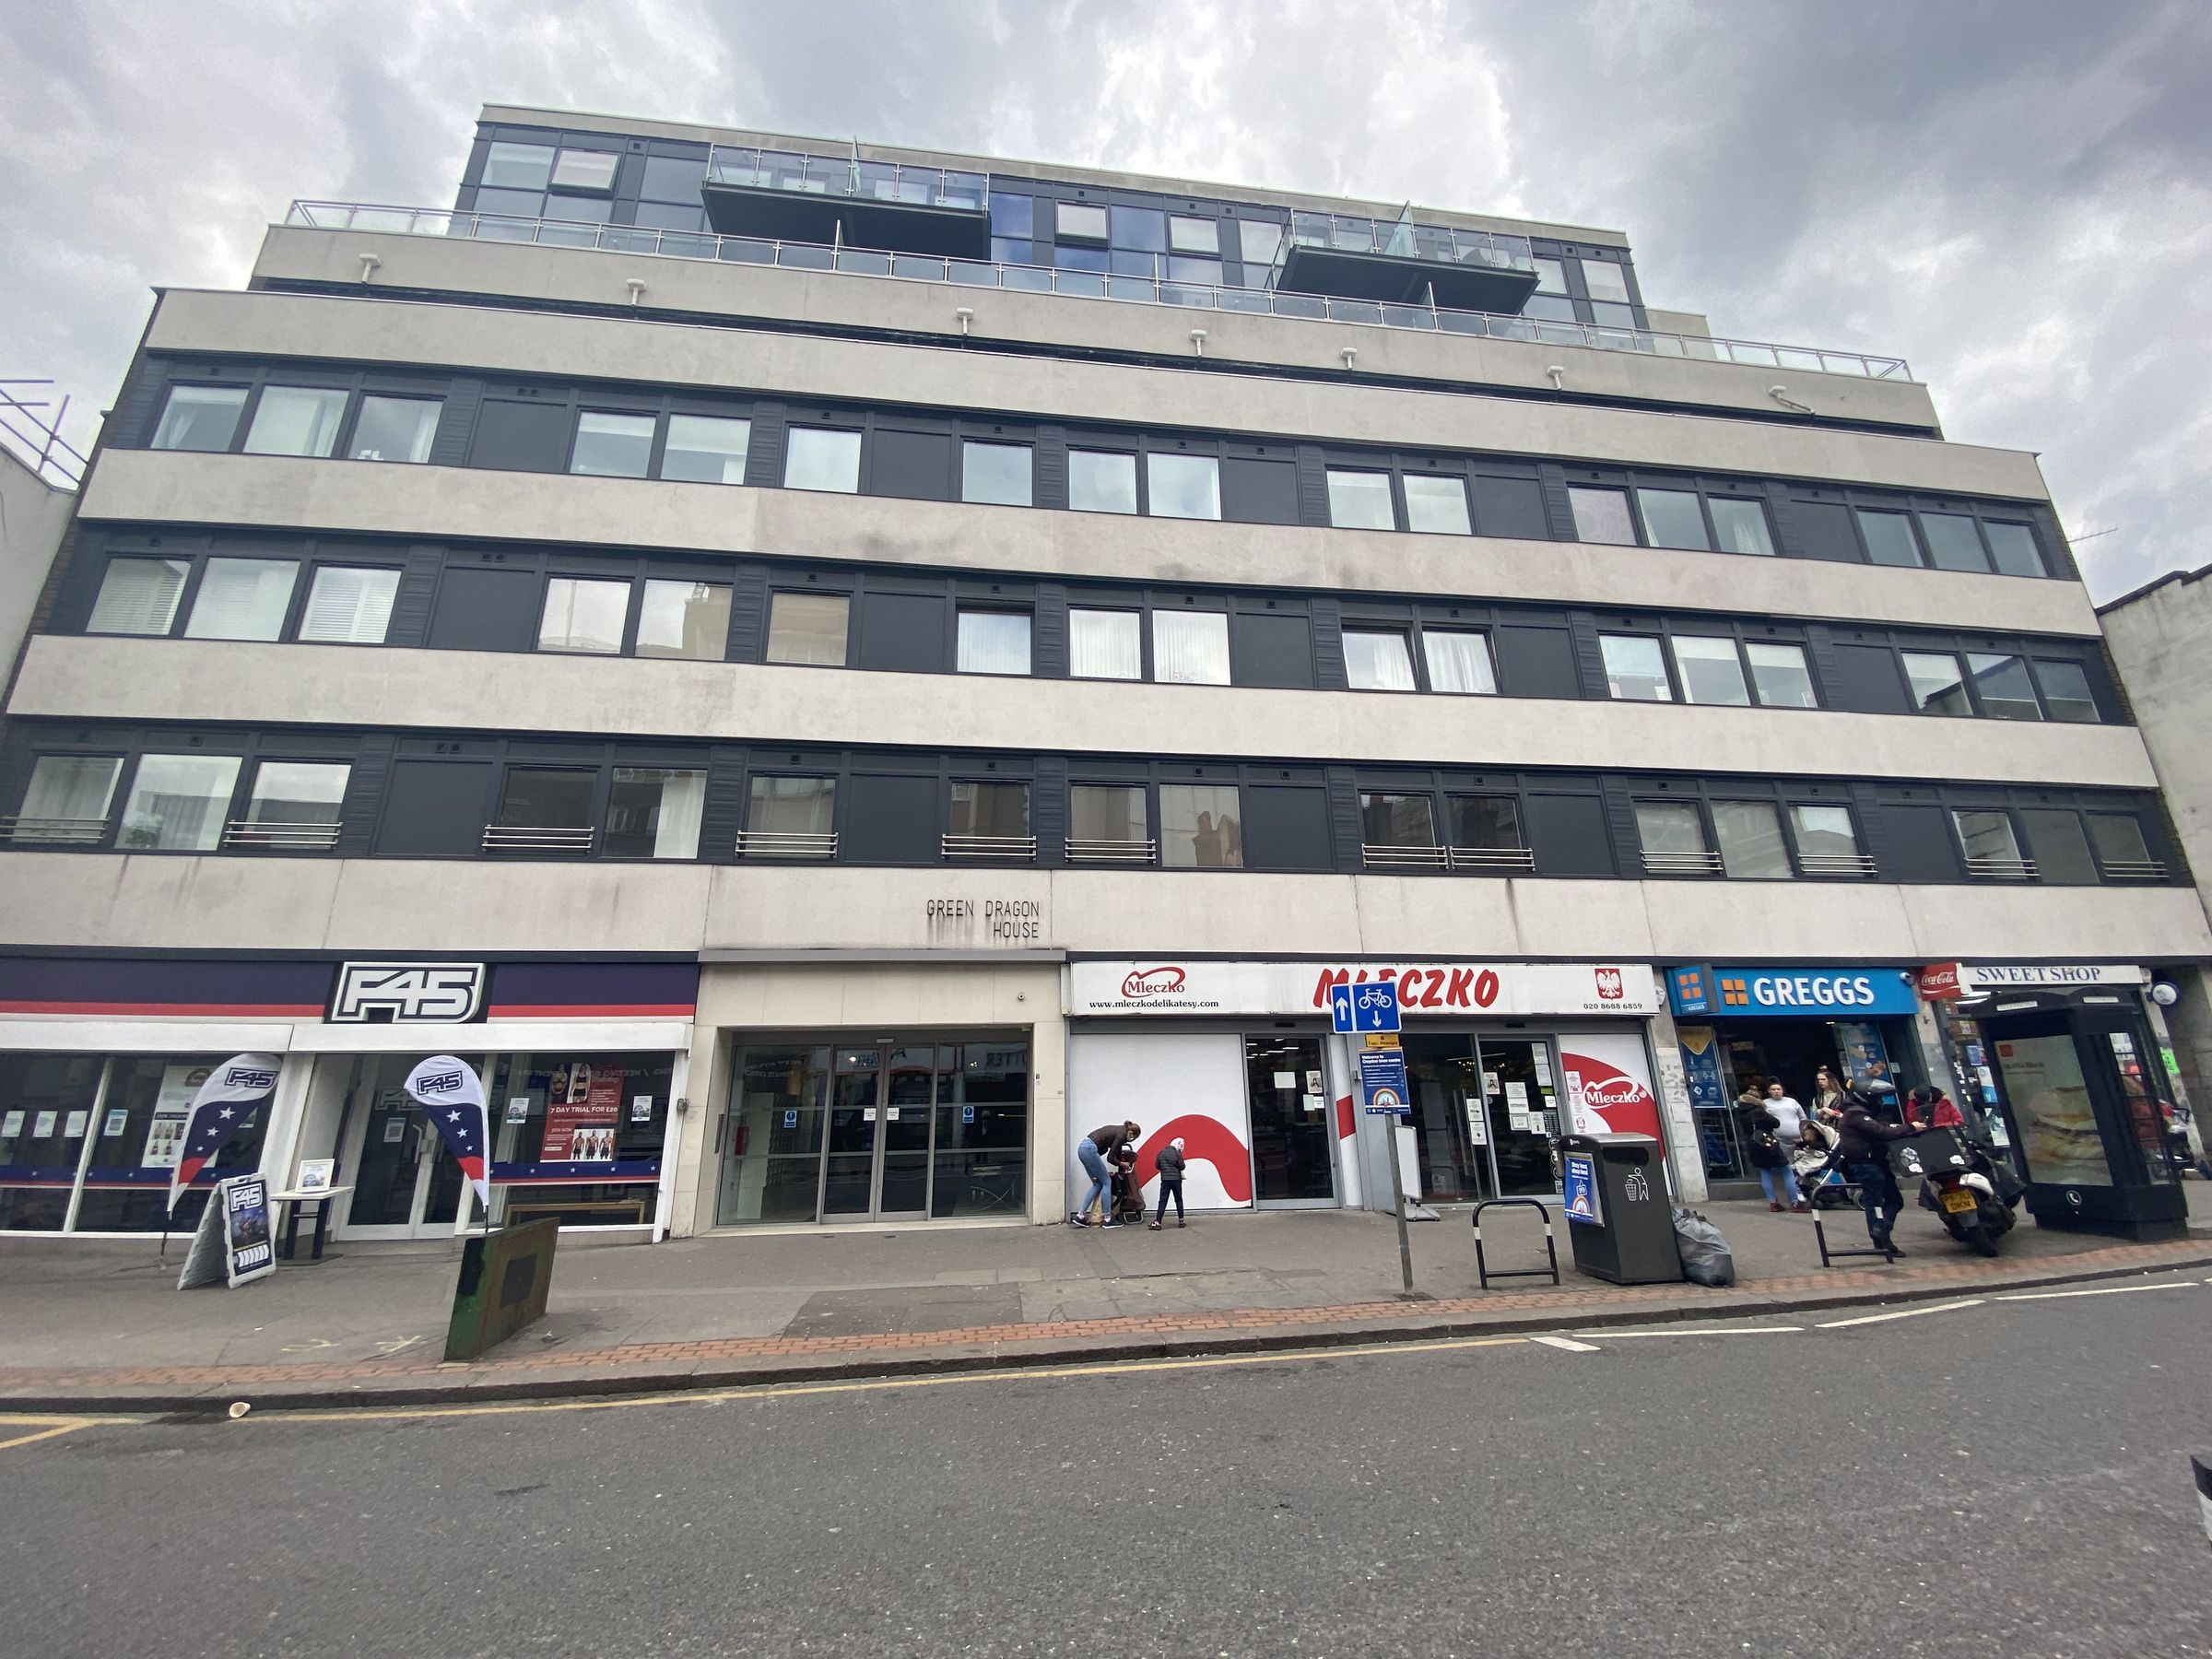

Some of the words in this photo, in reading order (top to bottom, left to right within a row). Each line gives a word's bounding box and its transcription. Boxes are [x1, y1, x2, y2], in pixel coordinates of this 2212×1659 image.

[927, 899, 974, 917] GREEN
[985, 900, 1040, 918] DRAGON
[994, 922, 1040, 938] HOUSE
[1977, 967, 2046, 982] SWEET
[2050, 967, 2100, 982] SHOP
[335, 964, 483, 1020] F45
[1127, 978, 1185, 994] Mleczko
[1753, 977, 1875, 1006] GREGGS
[1088, 998, 1219, 1009] www.mleczkodelikatesy.com
[224, 1067, 278, 1088] F45
[417, 1070, 463, 1096] F45
[1585, 1090, 1641, 1104] Mleczko
[229, 1182, 264, 1212] F45
